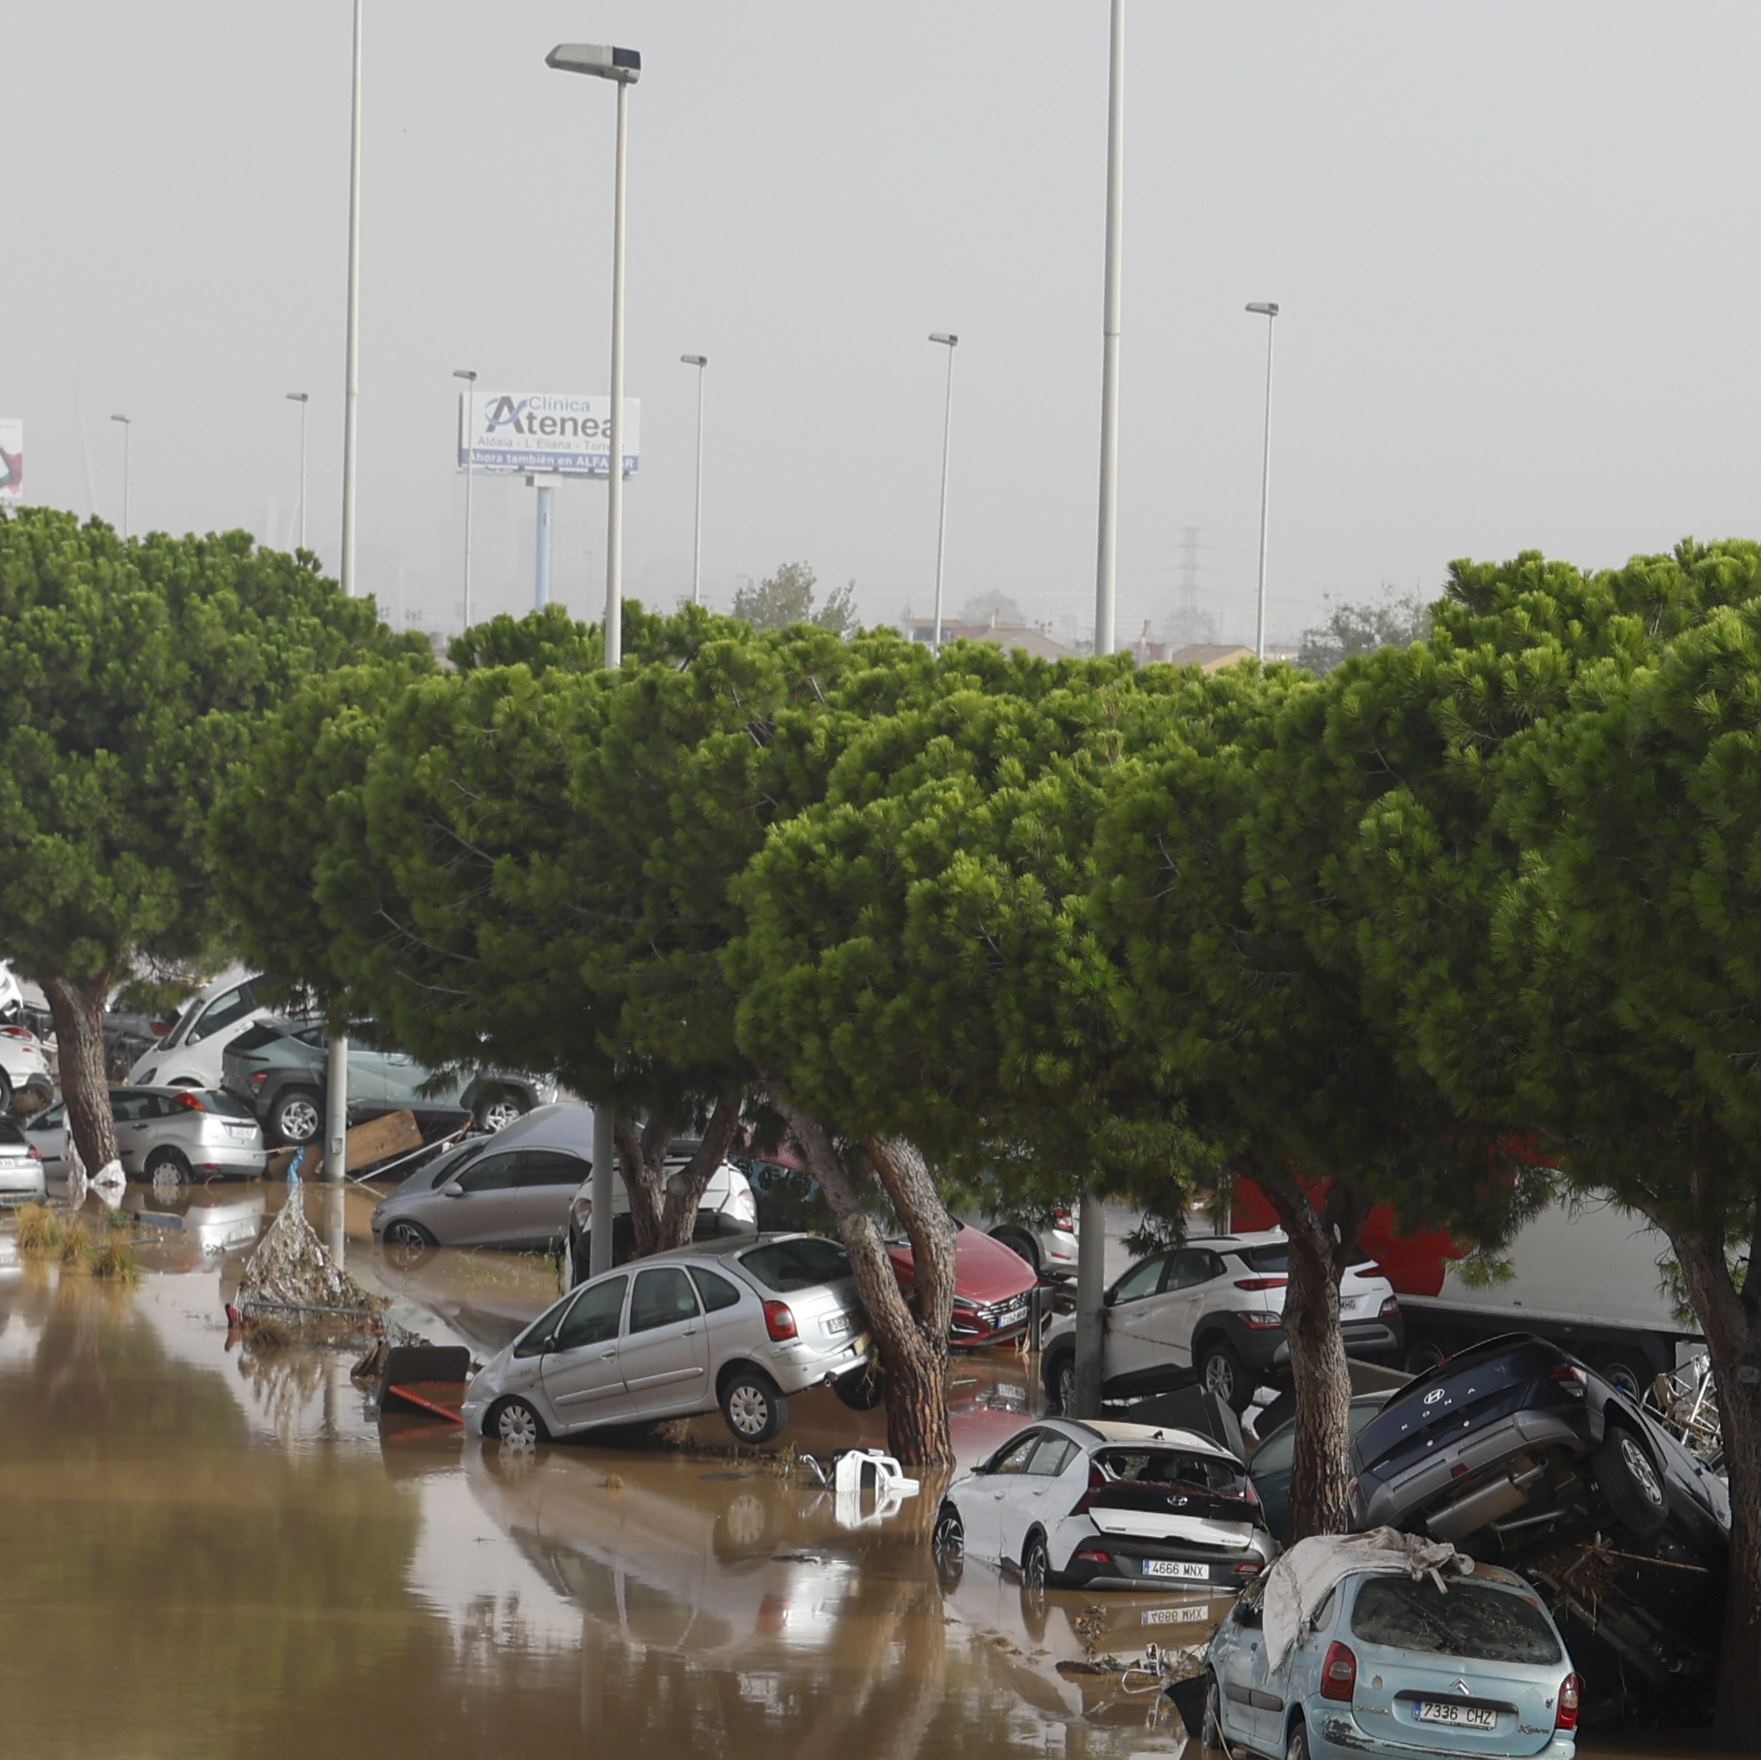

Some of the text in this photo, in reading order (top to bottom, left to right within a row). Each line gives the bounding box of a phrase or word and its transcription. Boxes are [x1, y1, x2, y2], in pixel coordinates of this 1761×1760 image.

[507, 453, 554, 467] también
[558, 457, 572, 466] en
[576, 457, 634, 469] ALFAR
[1152, 1561, 1204, 1577] 4666 MNX
[1422, 1701, 1459, 1720] 7336
[1466, 1708, 1493, 1725] CHZ
